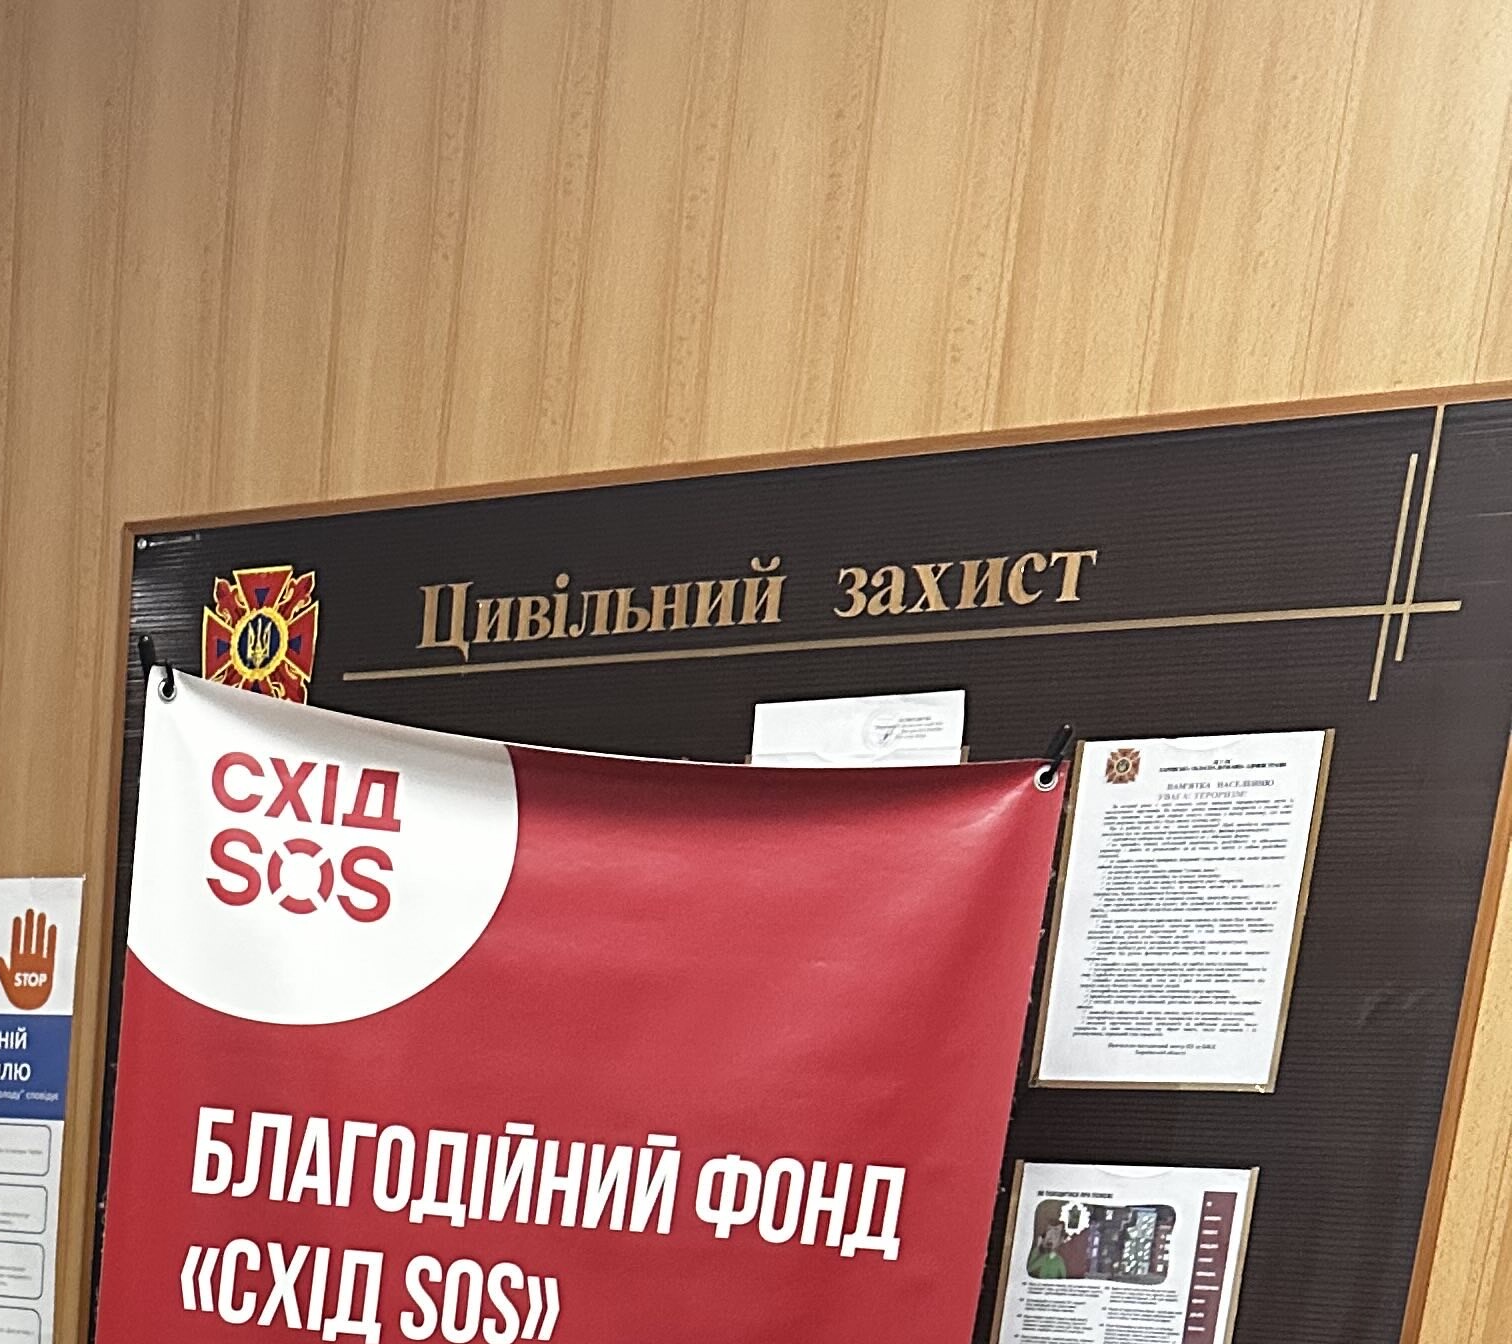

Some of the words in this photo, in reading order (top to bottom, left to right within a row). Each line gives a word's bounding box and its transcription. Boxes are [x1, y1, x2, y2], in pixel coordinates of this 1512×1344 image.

[419, 558, 785, 662] Цивільний
[834, 547, 1099, 621] захист
[212, 752, 401, 832] СХІД
[207, 828, 397, 924] SOS
[14, 972, 47, 987] STOP
[191, 1106, 682, 1236] БЛАГОДІЙНИЙ
[695, 1153, 906, 1262] ФОНД
[179, 1238, 383, 1344] «СХІД
